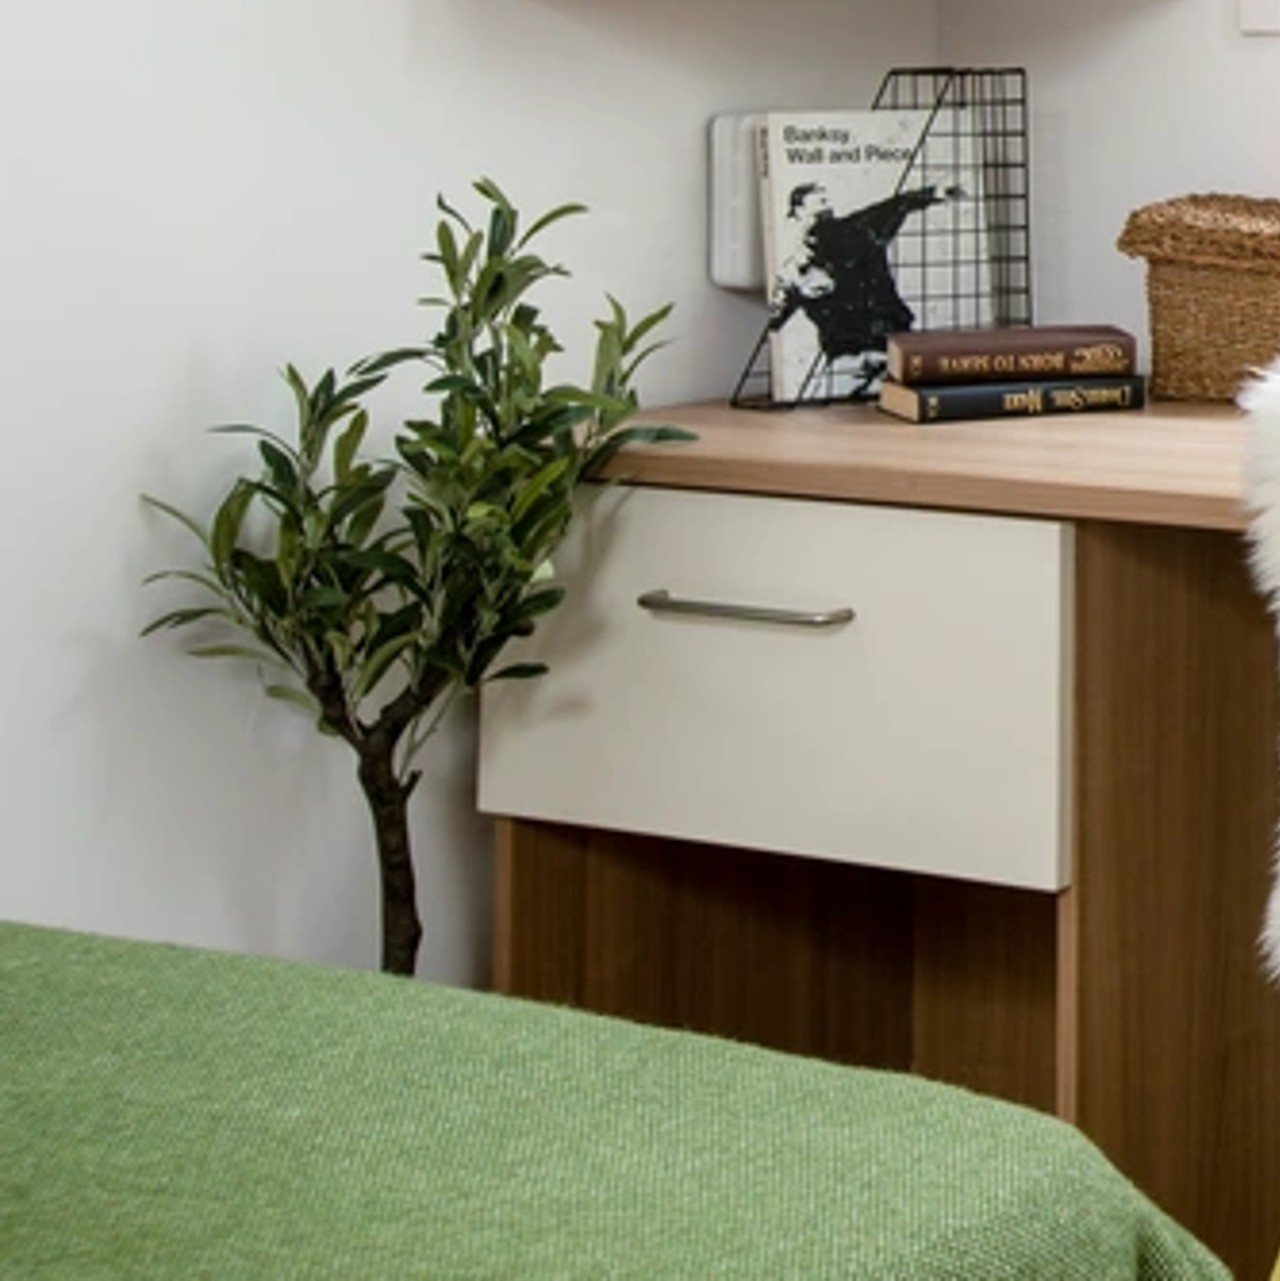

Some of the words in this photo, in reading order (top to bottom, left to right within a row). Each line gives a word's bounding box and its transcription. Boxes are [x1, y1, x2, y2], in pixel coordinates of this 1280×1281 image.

[783, 124, 849, 145] Banksy
[784, 147, 823, 164] Wall
[828, 146, 861, 163] and
[864, 143, 912, 163] Piece
